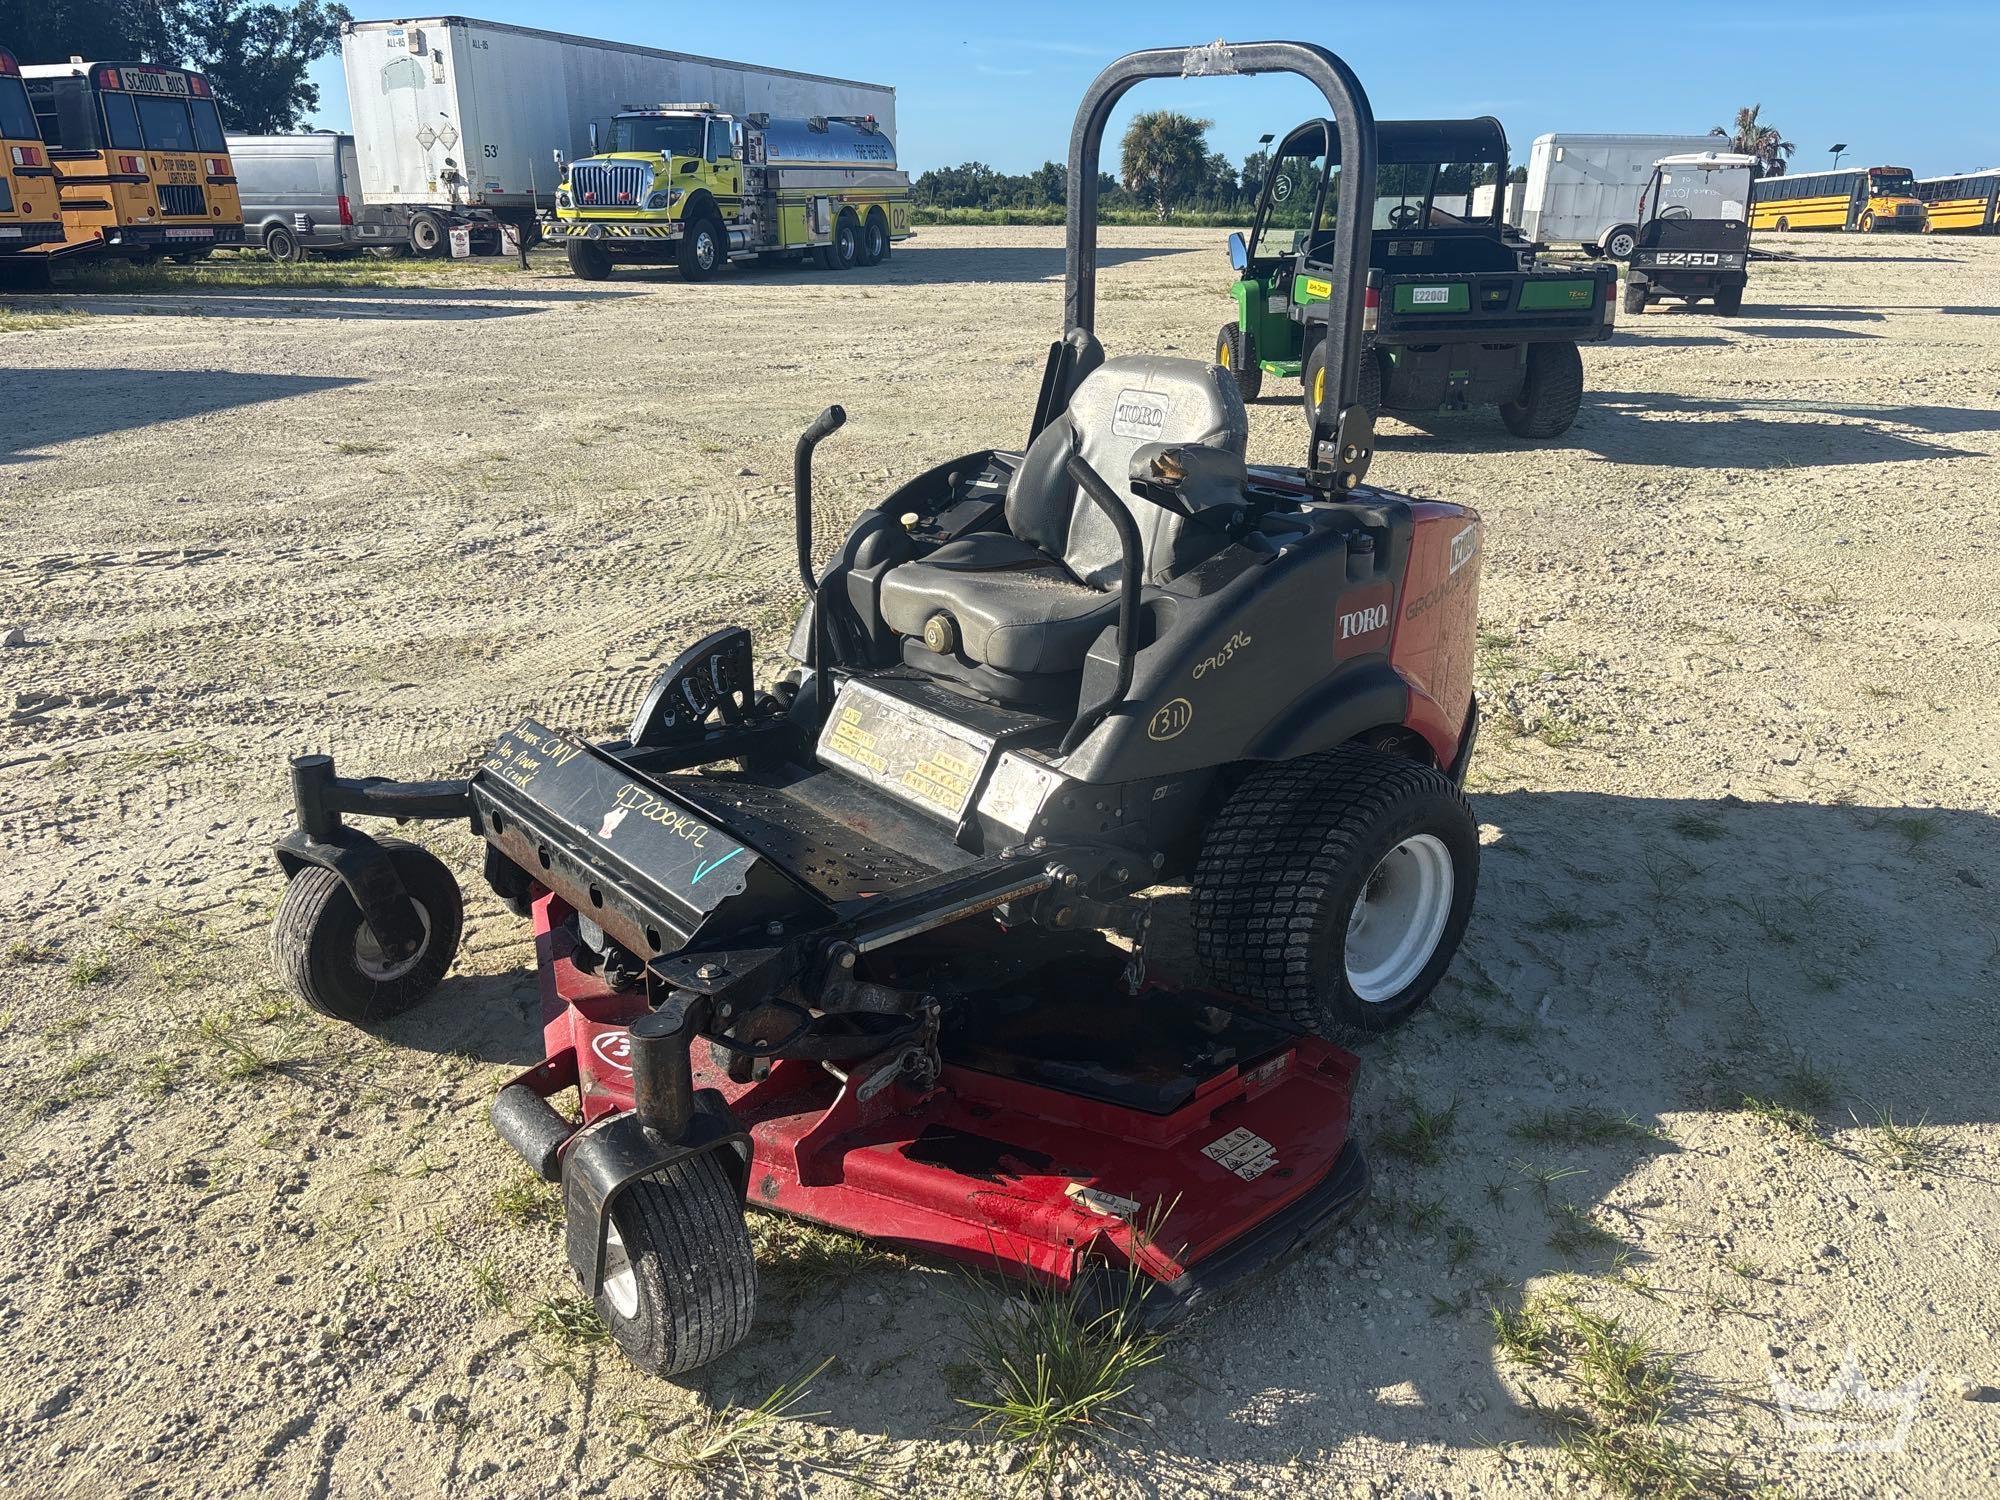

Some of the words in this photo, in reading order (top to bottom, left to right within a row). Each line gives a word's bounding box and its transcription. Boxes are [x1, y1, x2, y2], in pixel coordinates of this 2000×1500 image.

[125, 72, 164, 92] SCHOOL
[167, 75, 186, 94] BUS
[1119, 404, 1162, 427] TORO
[1339, 603, 1387, 640] TORO
[1151, 705, 1186, 734] 1311
